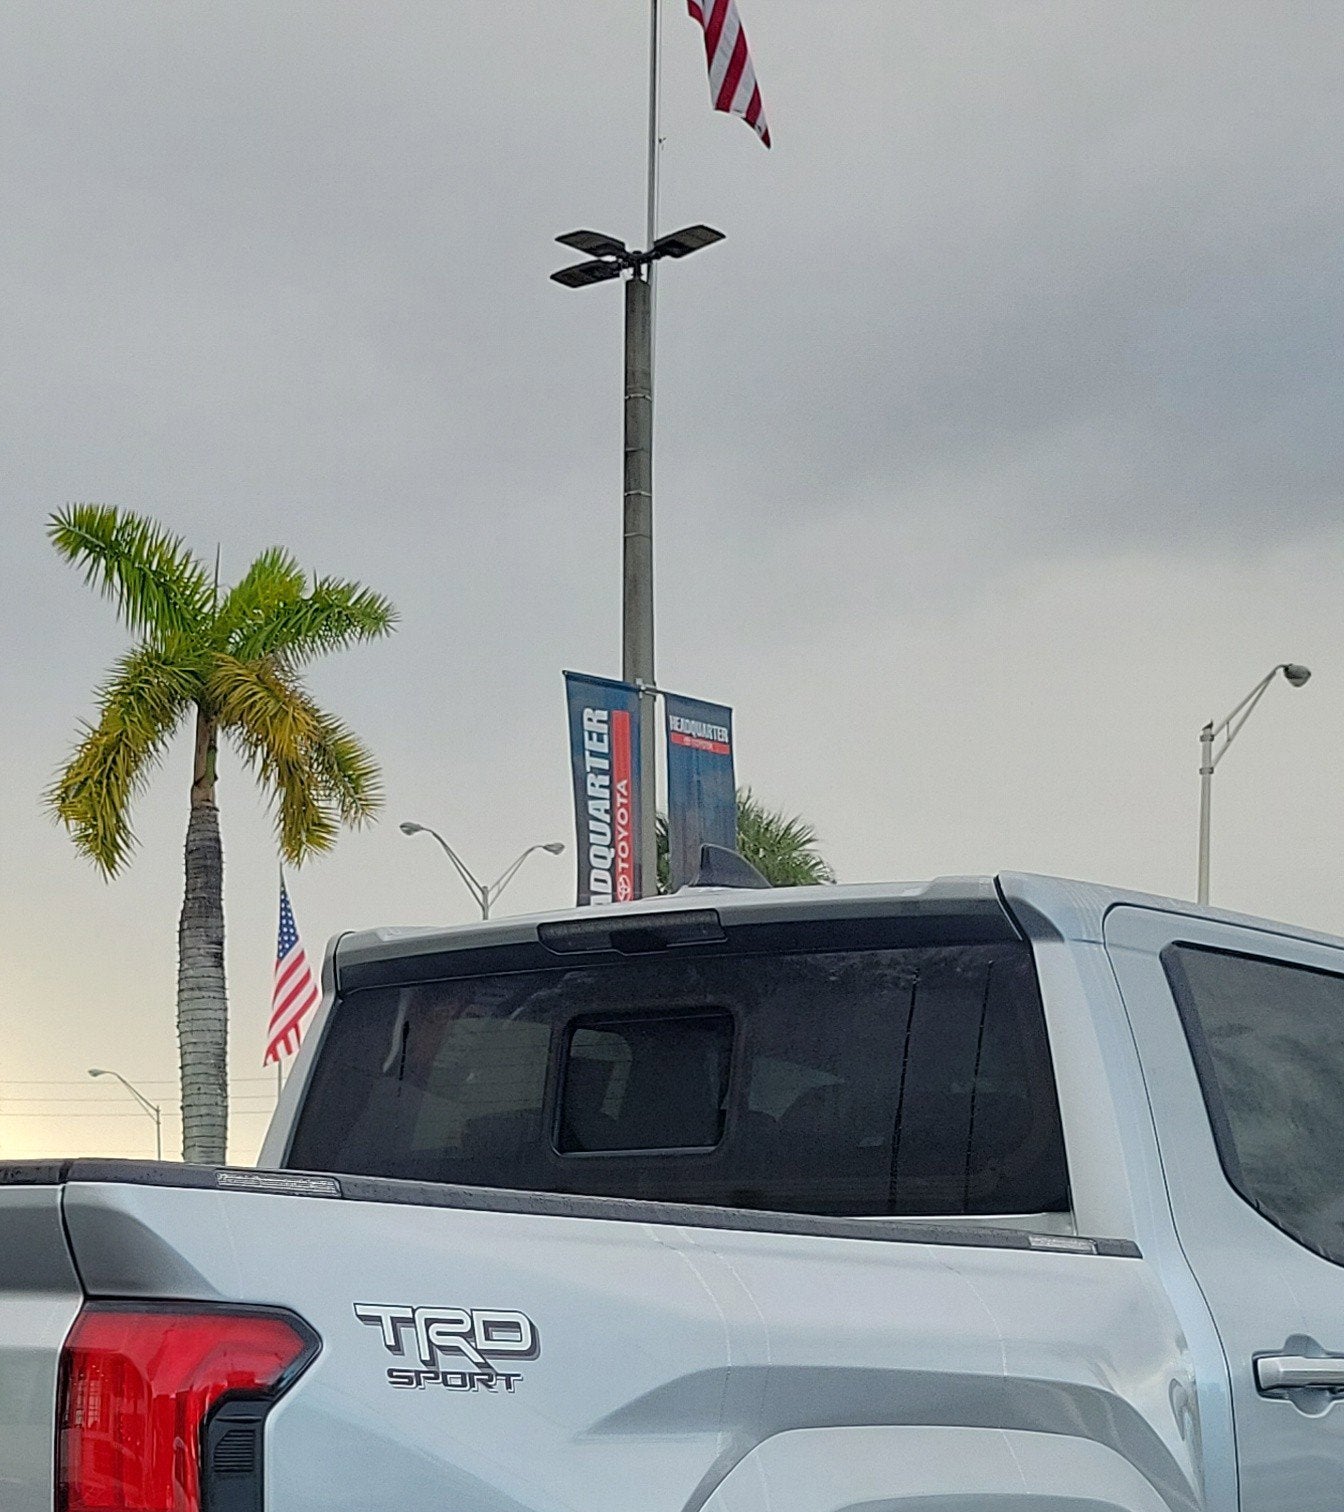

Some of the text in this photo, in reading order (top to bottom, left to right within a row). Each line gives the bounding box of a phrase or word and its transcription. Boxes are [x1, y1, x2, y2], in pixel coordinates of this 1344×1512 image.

[583, 707, 615, 905] ADQUARTER
[617, 779, 630, 867] TOYOTA
[353, 1303, 541, 1374] TRD
[387, 1367, 523, 1393] SPORT
